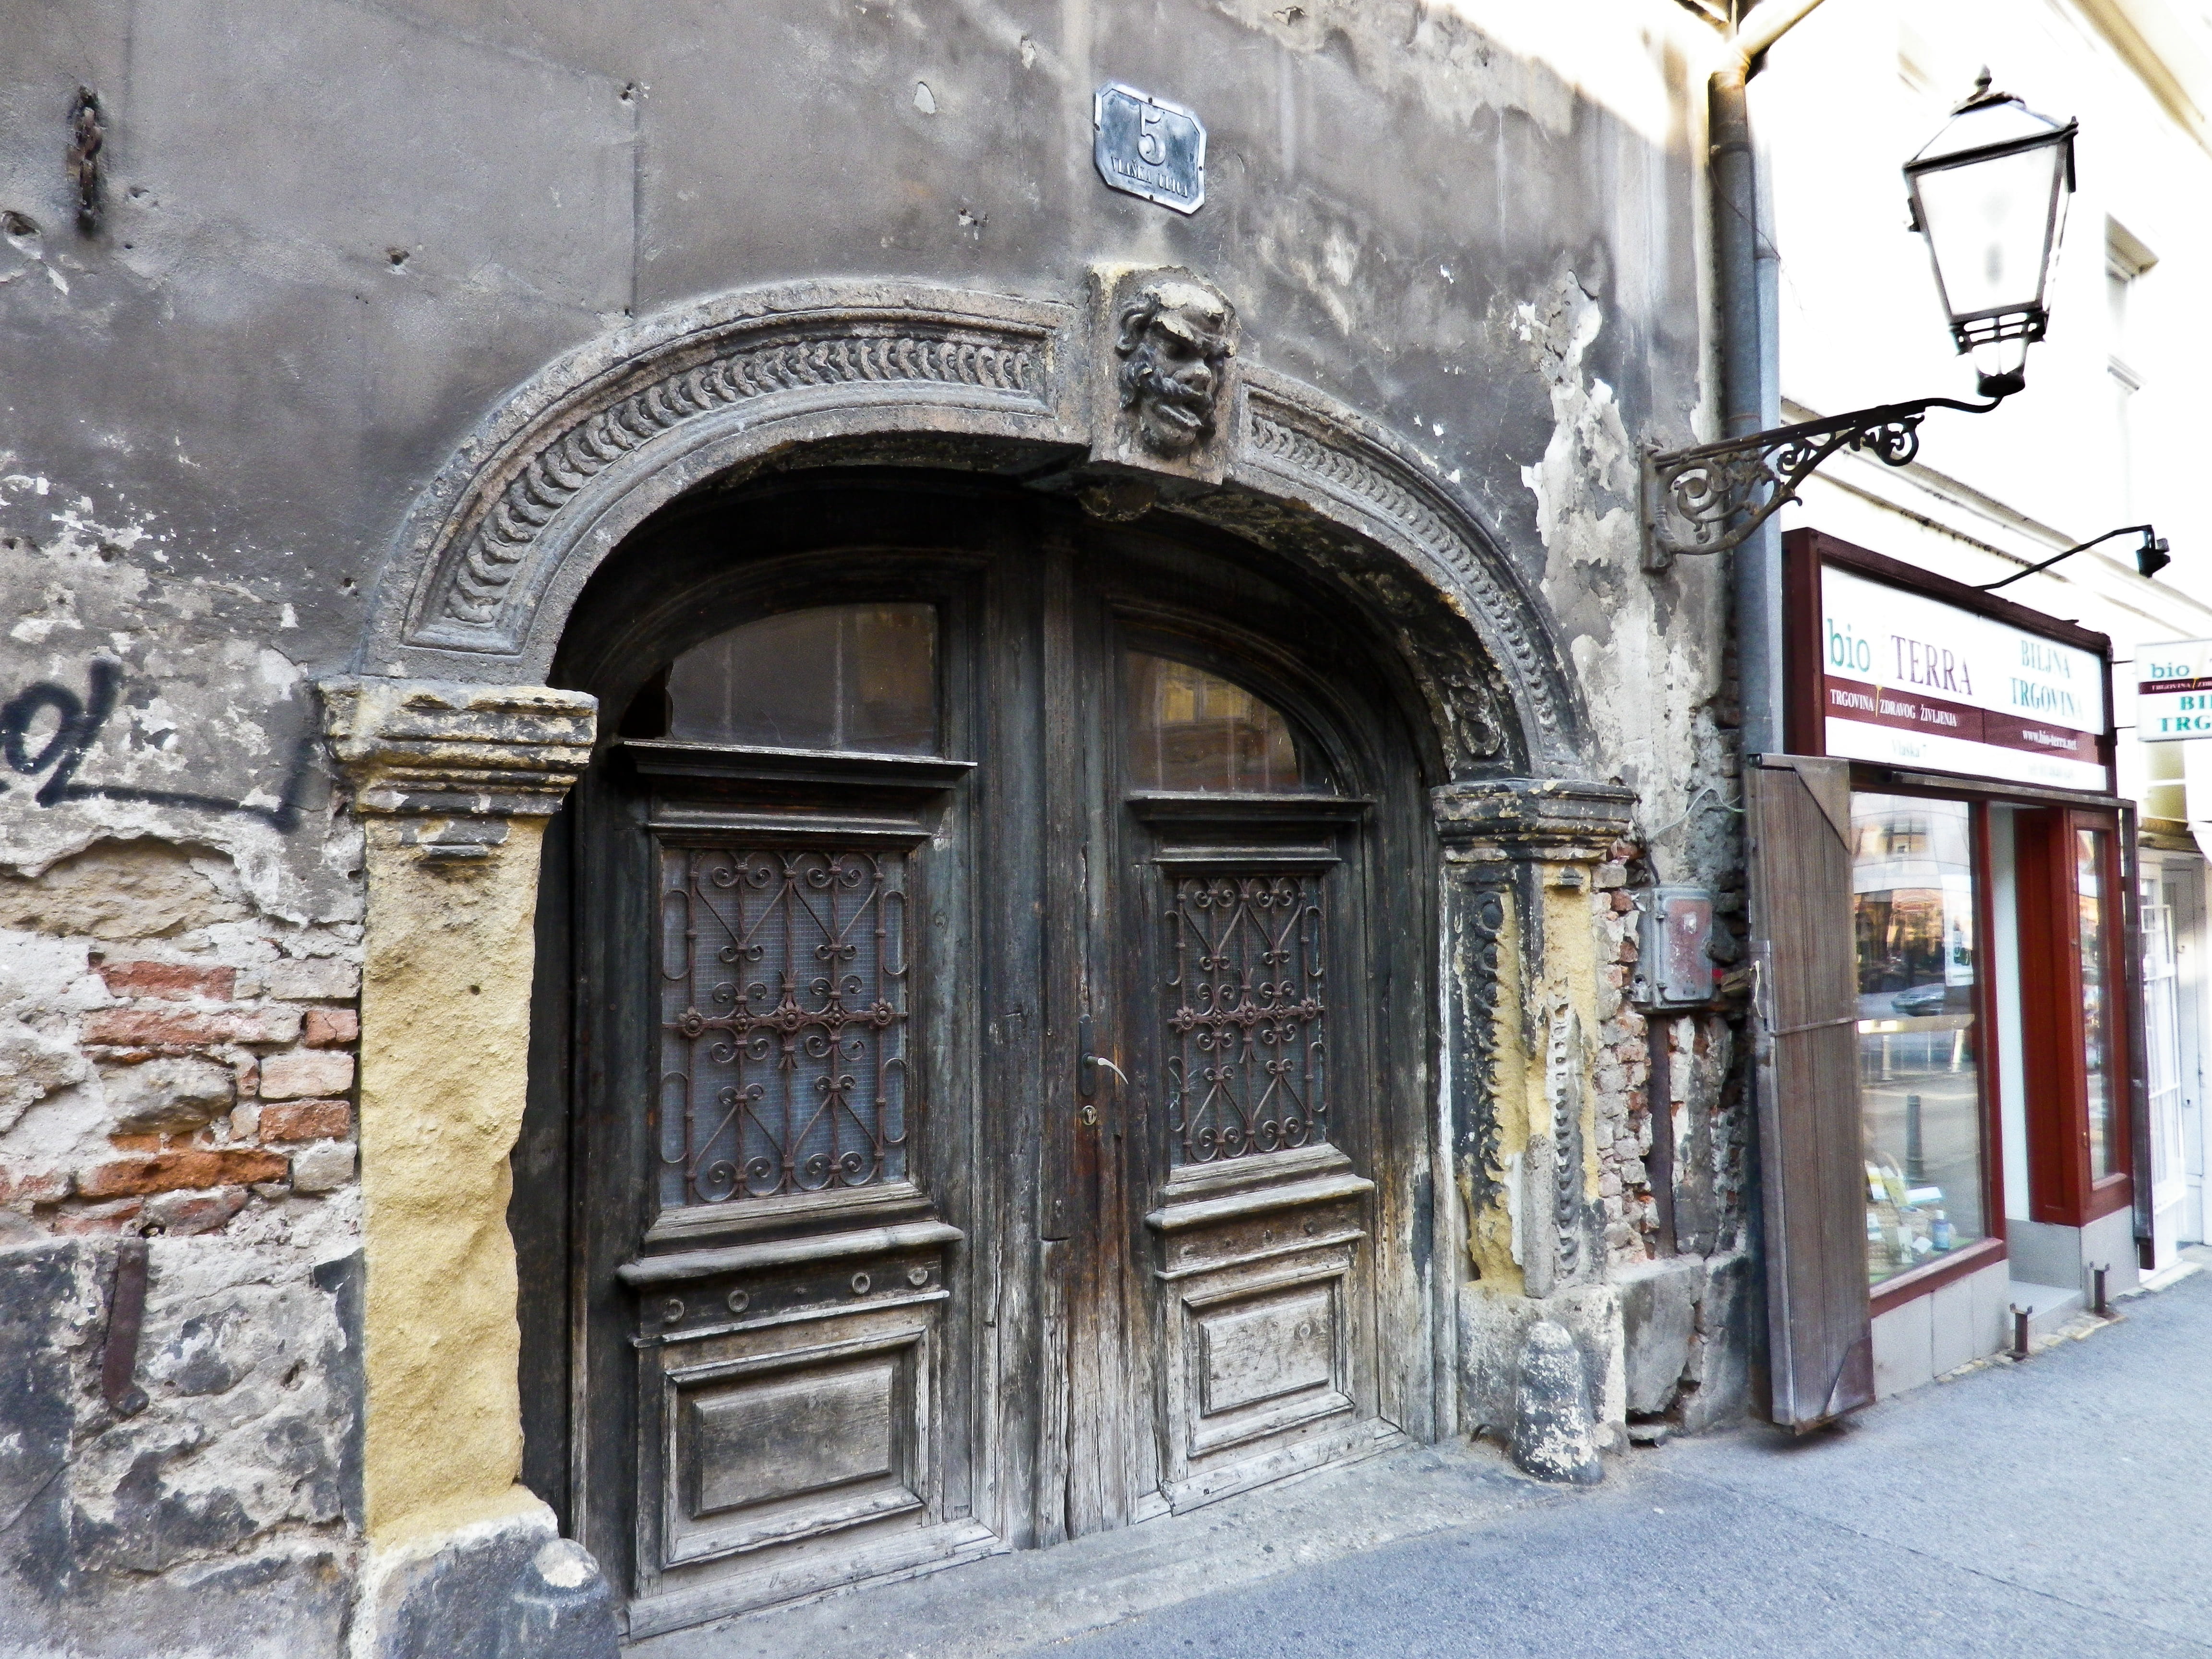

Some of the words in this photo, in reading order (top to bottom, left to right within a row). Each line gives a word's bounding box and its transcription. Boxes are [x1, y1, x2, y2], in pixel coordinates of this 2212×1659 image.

[1137, 102, 1166, 167] 5
[1158, 173, 1188, 199] ULICA
[1827, 618, 1870, 673] bio
[1890, 635, 1972, 696] TERRA
[2021, 640, 2070, 679] BILJNA
[2151, 662, 2189, 678] bio
[1830, 689, 1875, 712] TRGOVINA
[1880, 699, 1916, 720] ZDRAVOG
[1920, 704, 1957, 727] ŽIVLJENJA
[2009, 676, 2084, 720] TRGOVINA
